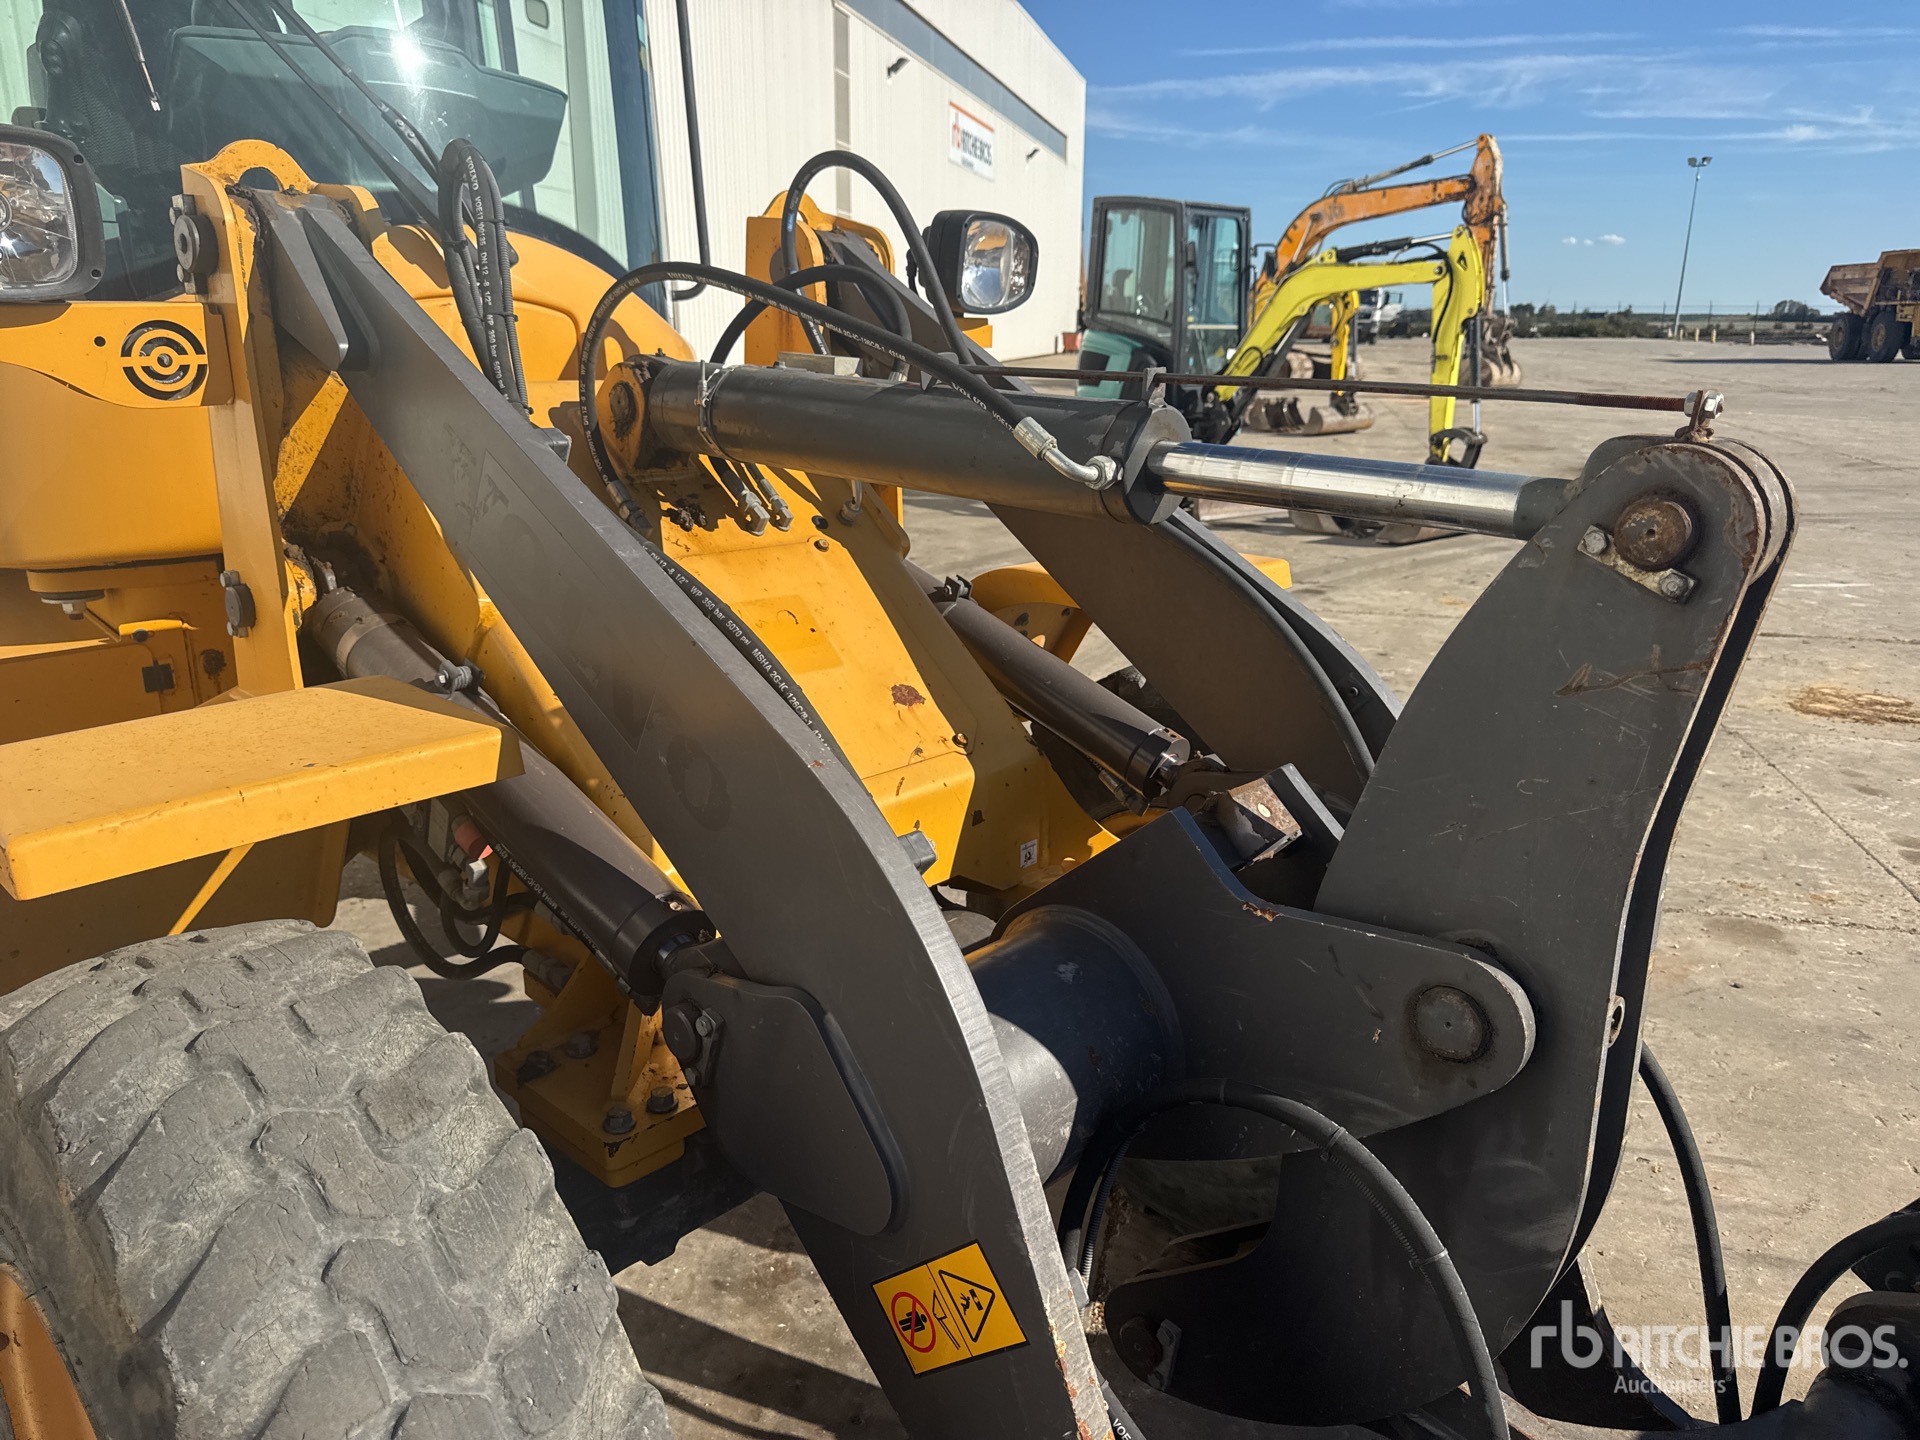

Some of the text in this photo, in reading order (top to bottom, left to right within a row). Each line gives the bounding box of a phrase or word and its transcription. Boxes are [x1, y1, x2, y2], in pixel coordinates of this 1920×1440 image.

[466, 156, 479, 191] VOLVO
[475, 196, 487, 246] VOE1700135
[480, 251, 487, 264] DN
[482, 265, 489, 275] 12
[490, 344, 498, 358] bar
[952, 382, 986, 410] VOLVO
[583, 415, 589, 425] DN
[675, 573, 689, 585] 1/2"
[690, 586, 702, 597] WP
[702, 598, 715, 611] 350
[713, 607, 726, 620] bar
[725, 620, 743, 637] 5070
[740, 635, 751, 646] psi
[752, 648, 772, 671] MSHA
